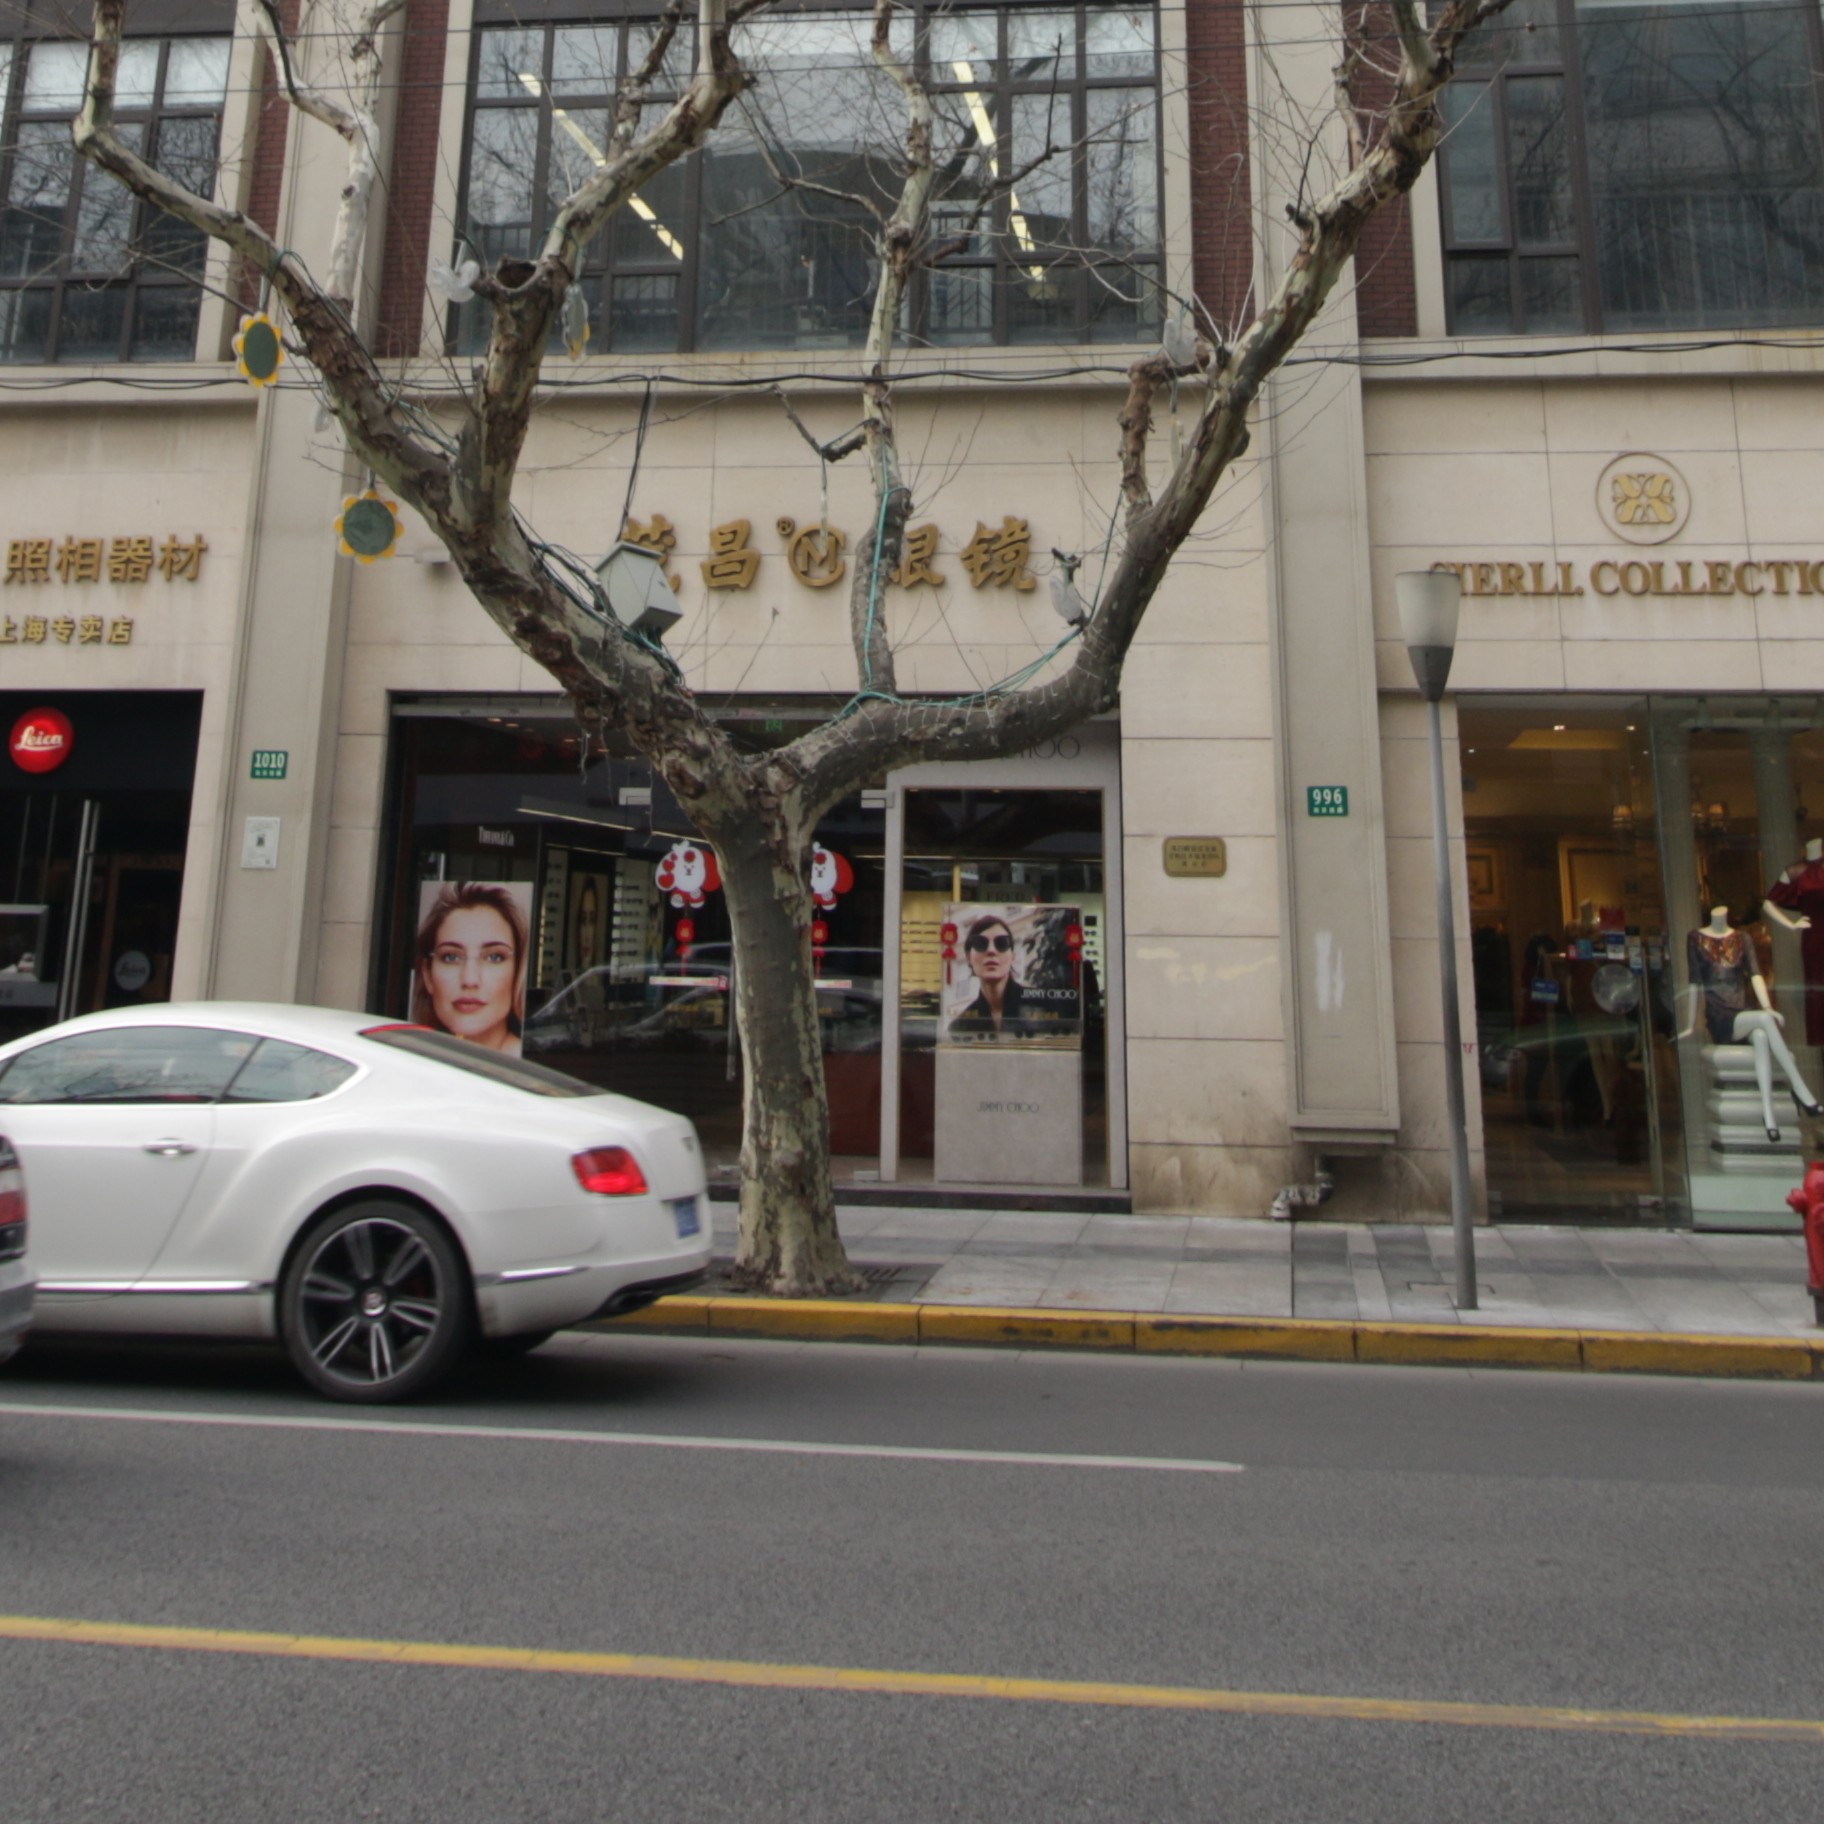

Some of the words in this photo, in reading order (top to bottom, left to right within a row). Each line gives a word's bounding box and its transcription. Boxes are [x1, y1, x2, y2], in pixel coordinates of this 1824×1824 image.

[14, 726, 64, 752] Leica
[255, 753, 285, 769] 1010
[1312, 788, 1342, 805] 996
[1047, 988, 1077, 999] CHOO
